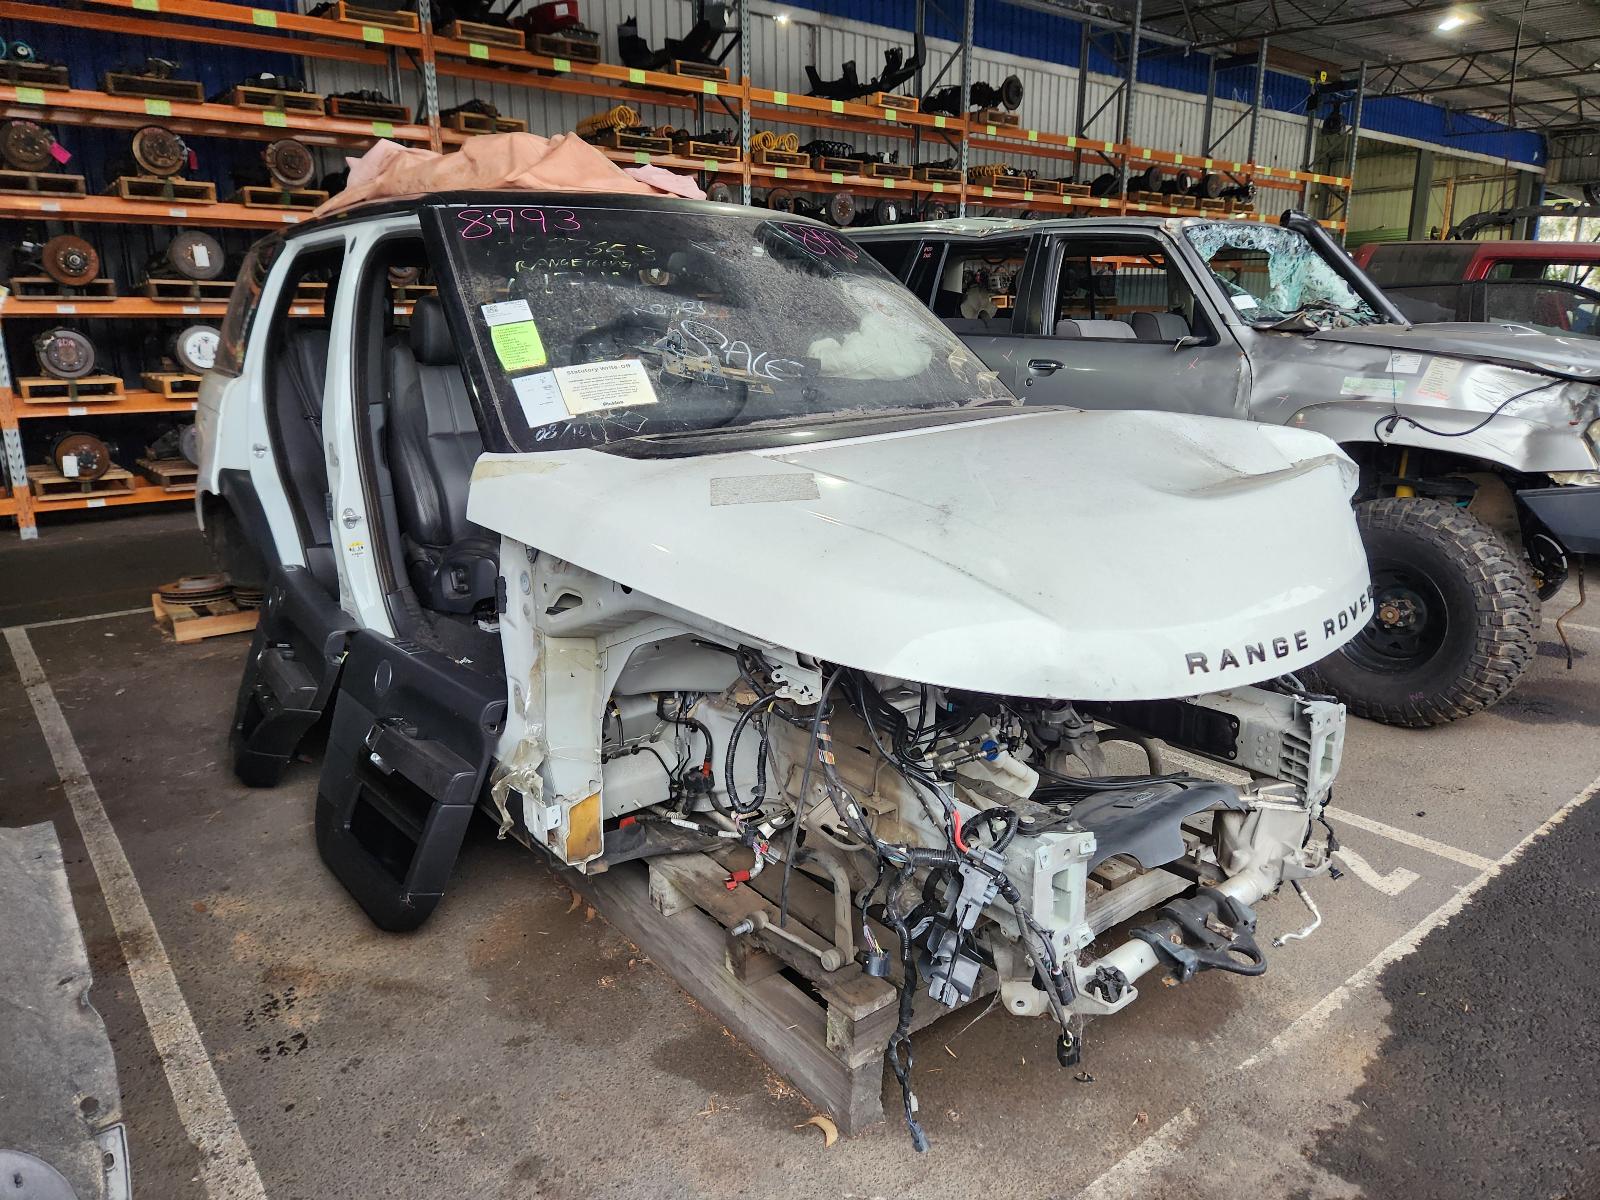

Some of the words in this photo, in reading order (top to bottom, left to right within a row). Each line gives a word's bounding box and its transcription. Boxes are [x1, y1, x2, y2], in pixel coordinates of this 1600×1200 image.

[457, 208, 581, 239] 8993
[566, 366, 599, 376] Statutory
[1184, 629, 1309, 675] RANGE
[1322, 584, 1374, 640] ROVER
